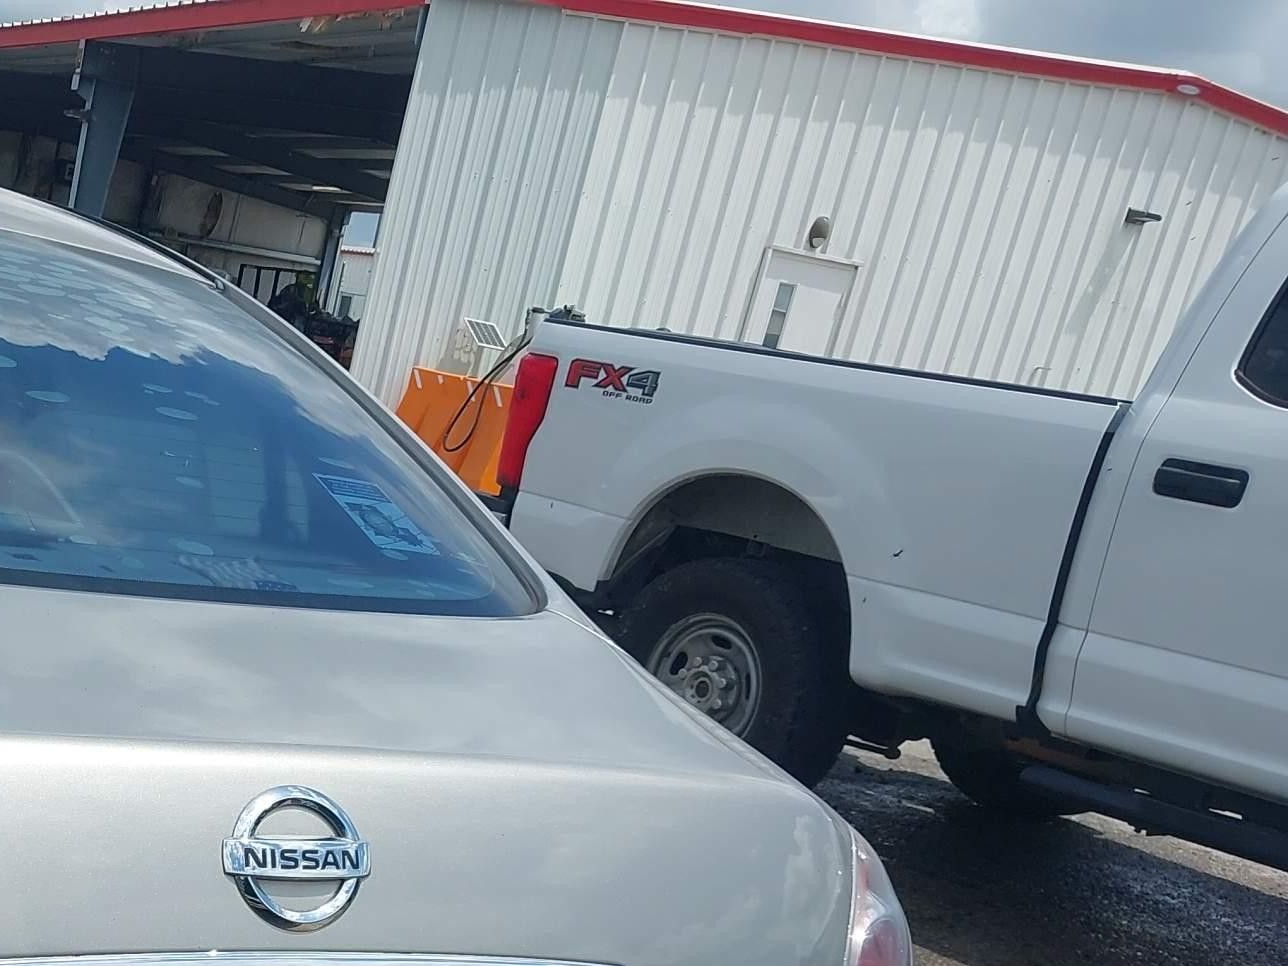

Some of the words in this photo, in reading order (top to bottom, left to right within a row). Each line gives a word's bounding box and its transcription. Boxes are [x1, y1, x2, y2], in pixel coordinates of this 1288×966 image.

[565, 358, 661, 398] FX4
[602, 390, 623, 399] OFF
[625, 395, 653, 405] ROAD
[244, 847, 360, 870] NISSAN
